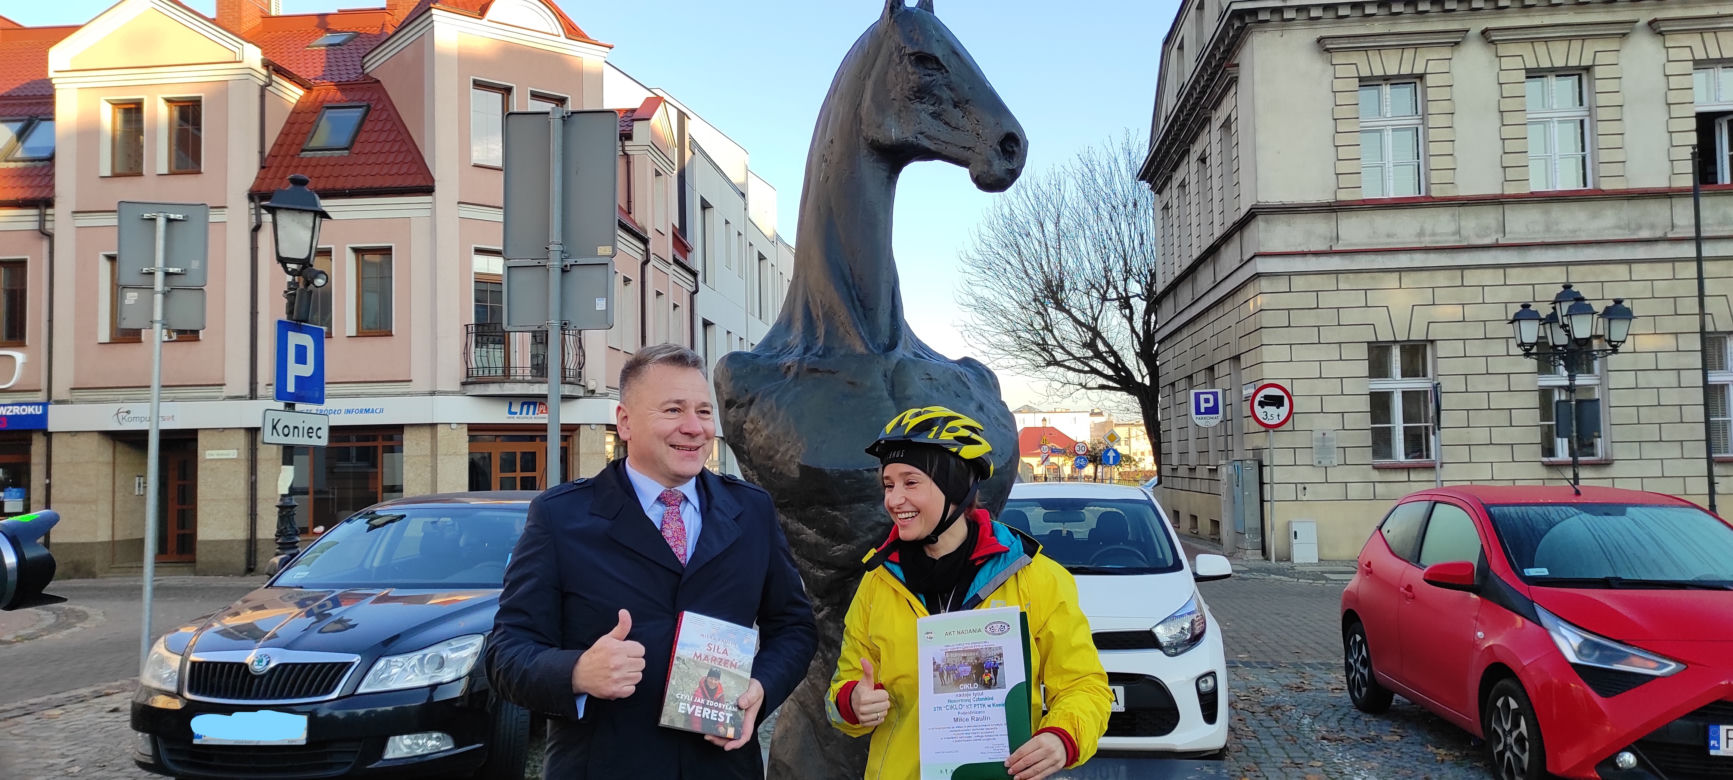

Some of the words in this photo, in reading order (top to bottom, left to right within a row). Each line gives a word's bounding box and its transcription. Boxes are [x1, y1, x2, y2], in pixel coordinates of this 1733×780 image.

[286, 331, 315, 393] P
[343, 407, 384, 415] INFORMACJI
[1200, 393, 1214, 413] P
[271, 418, 322, 439] Koniec
[706, 642, 729, 657] SIŁA
[693, 651, 738, 670] MARZEŃ
[959, 682, 979, 690] CIKLO
[675, 693, 693, 702] CZYLI
[694, 696, 706, 704] JAK
[678, 702, 733, 724] EVEREST
